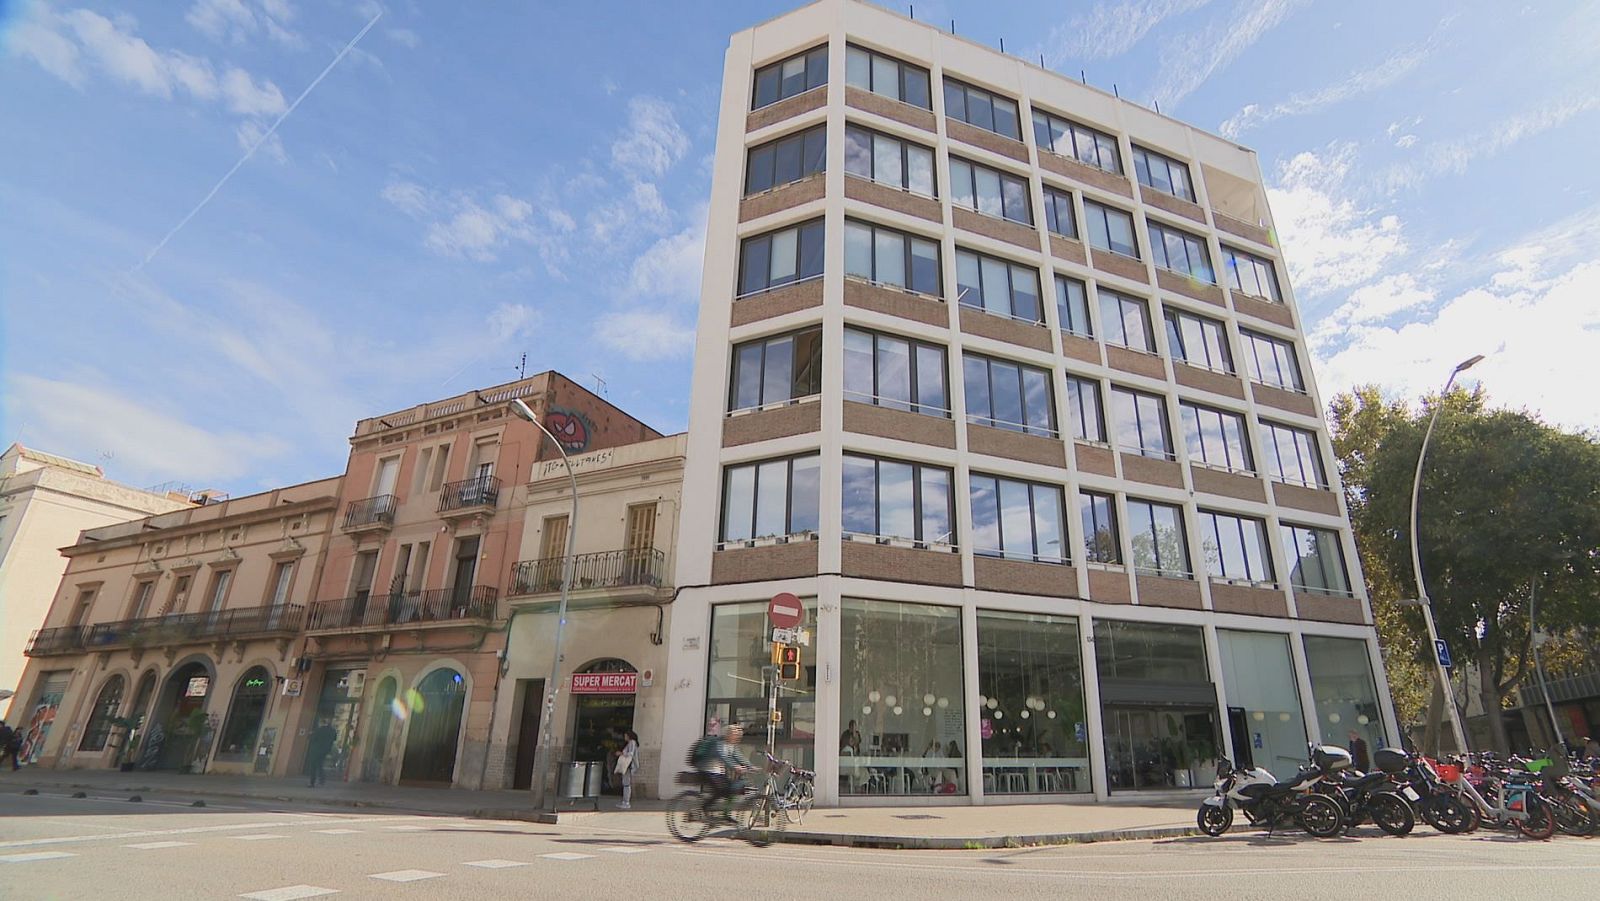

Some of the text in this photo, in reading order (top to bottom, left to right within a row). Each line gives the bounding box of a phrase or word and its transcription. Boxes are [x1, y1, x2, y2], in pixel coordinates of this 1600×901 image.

[1437, 643, 1444, 654] P
[574, 676, 600, 687] SUPER
[601, 675, 636, 687] MERCAT
